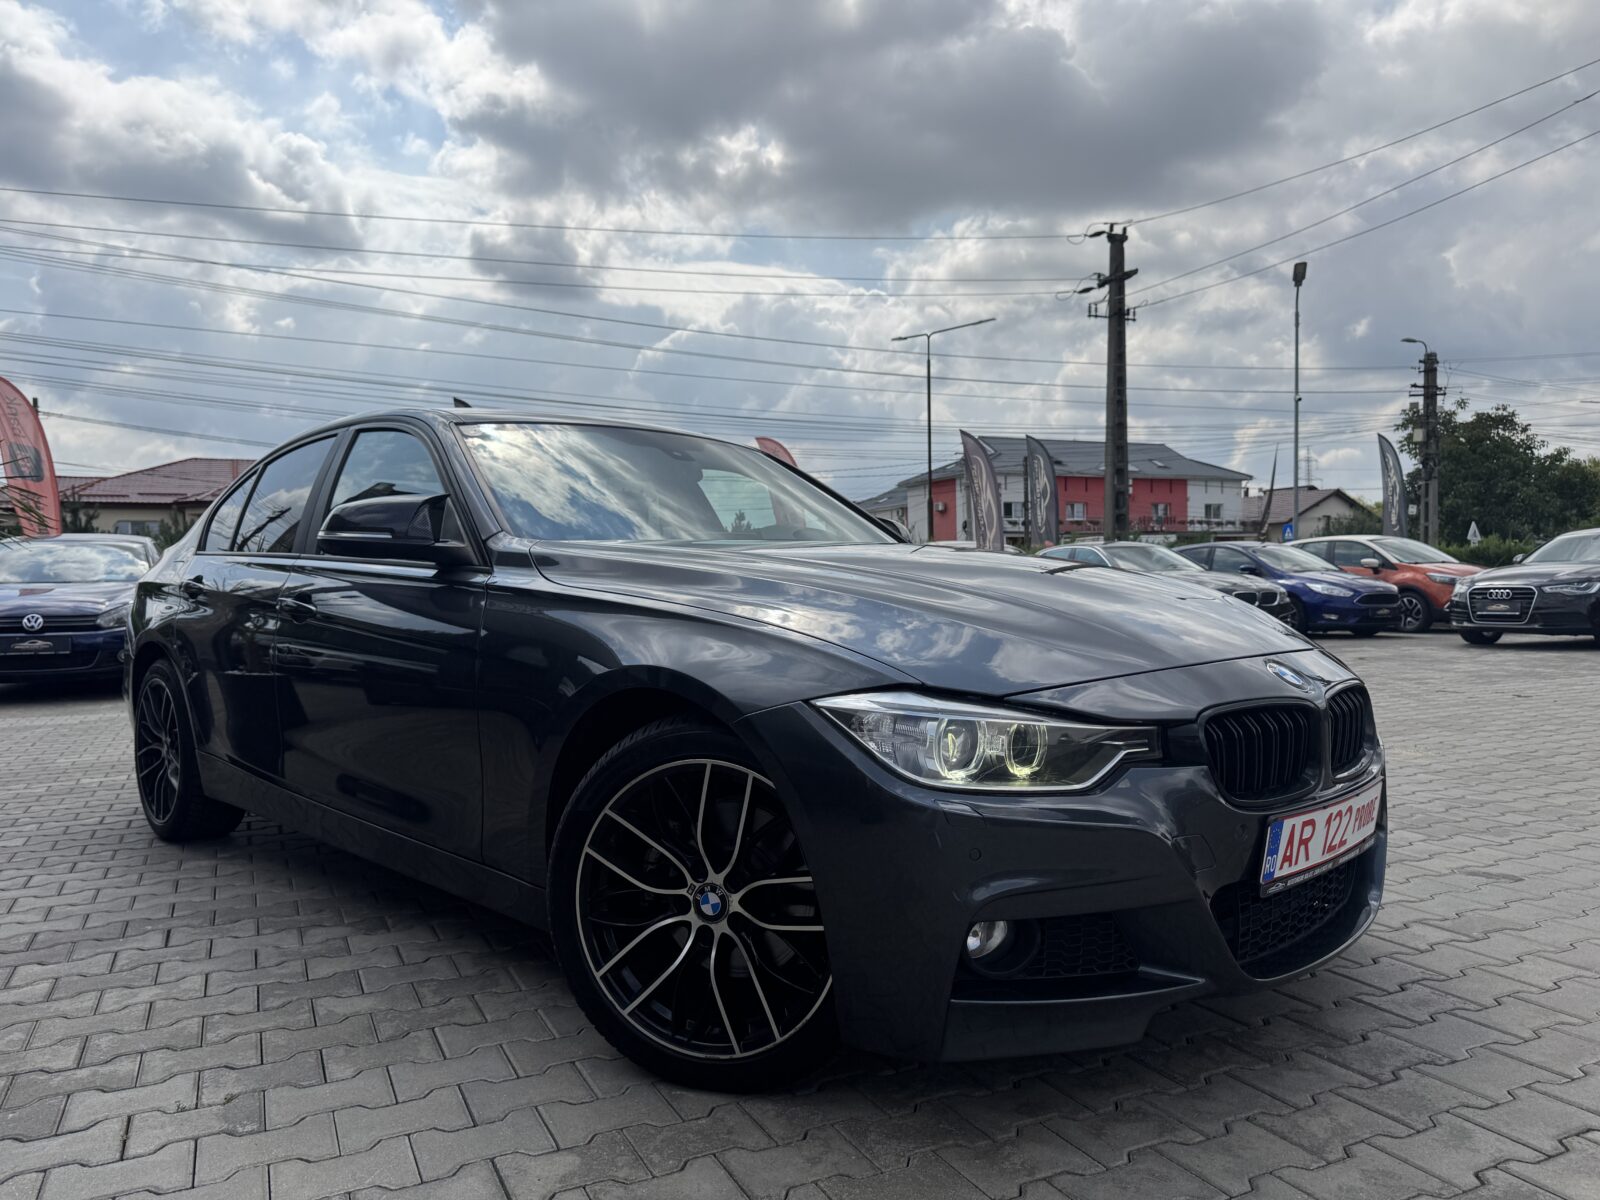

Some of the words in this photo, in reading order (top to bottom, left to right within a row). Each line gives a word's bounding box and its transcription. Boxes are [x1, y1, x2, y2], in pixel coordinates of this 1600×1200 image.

[1279, 818, 1316, 870] AR
[1322, 805, 1353, 856] 122
[1352, 796, 1379, 834] PROBE
[1264, 855, 1277, 874] RO
[694, 885, 723, 900] BMW
